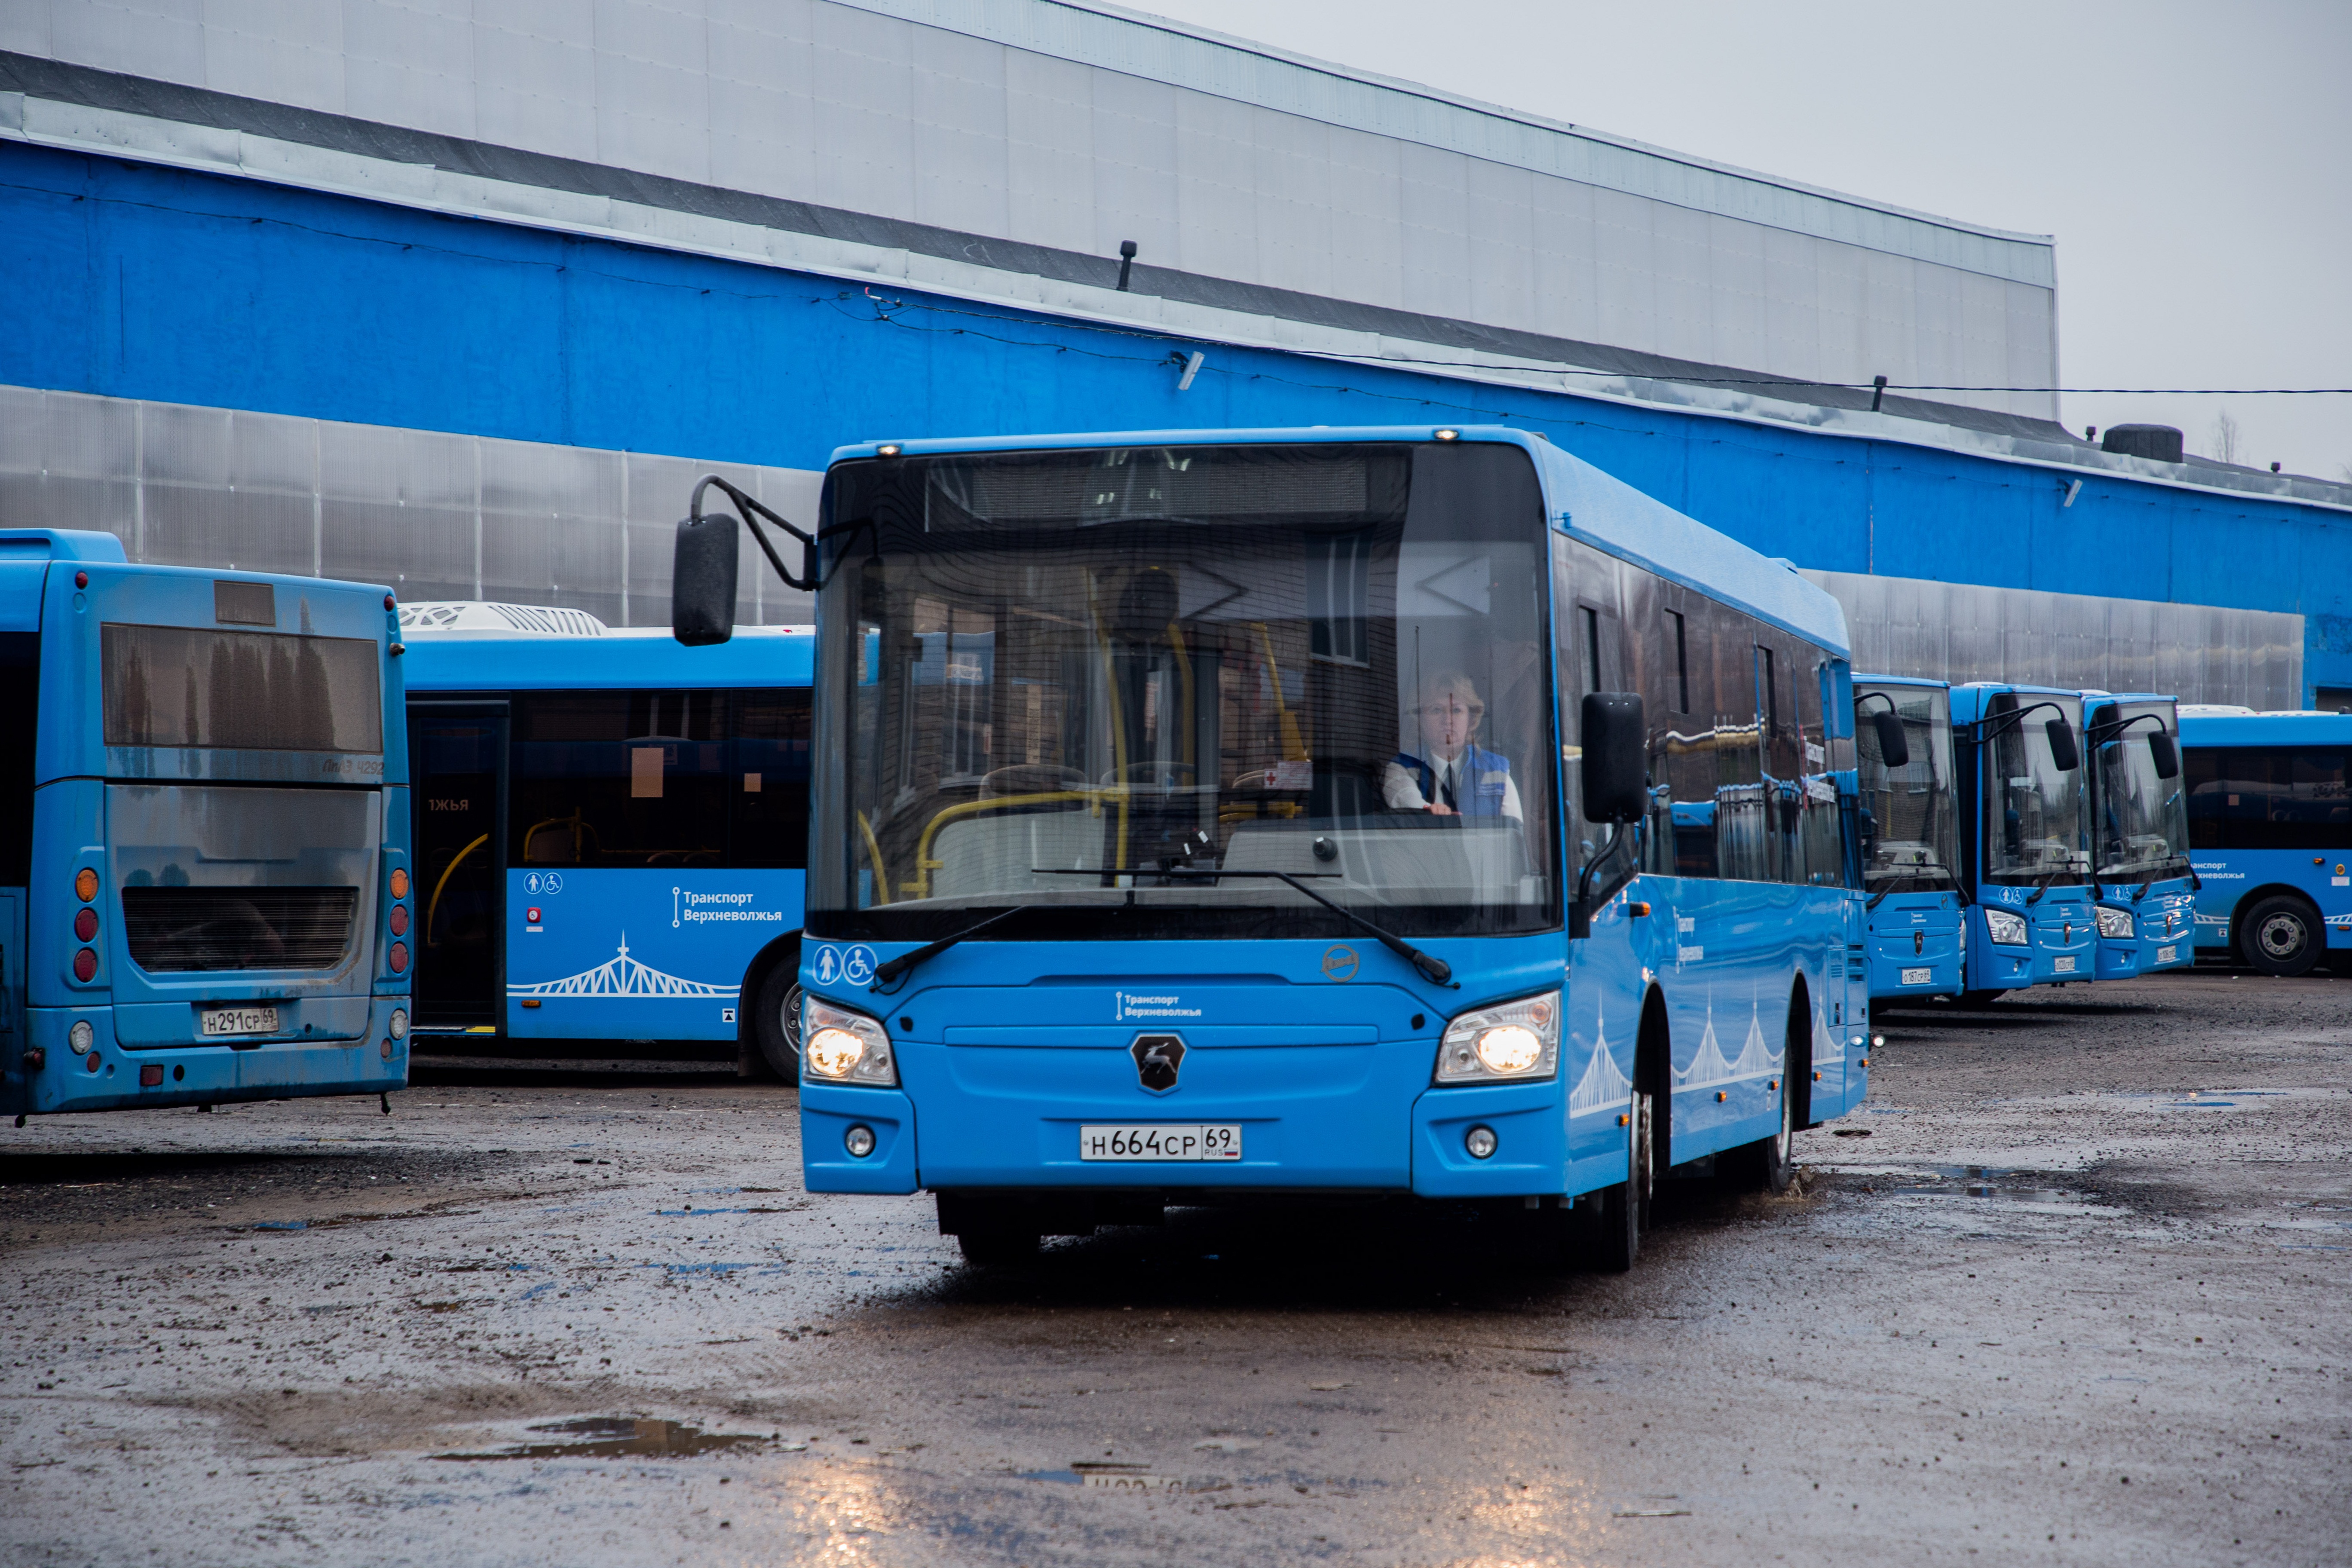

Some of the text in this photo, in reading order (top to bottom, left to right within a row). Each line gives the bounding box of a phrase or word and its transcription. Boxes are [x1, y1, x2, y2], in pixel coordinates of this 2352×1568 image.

[357, 761, 384, 775] 4292
[683, 891, 753, 906] Транспорт
[684, 909, 782, 924] Верхневолжья
[1124, 995, 1179, 1006] Транспорт
[263, 1009, 273, 1023] 69
[1125, 1007, 1201, 1018] Верхневолжья
[1092, 1129, 1231, 1155] Н664СР 69
